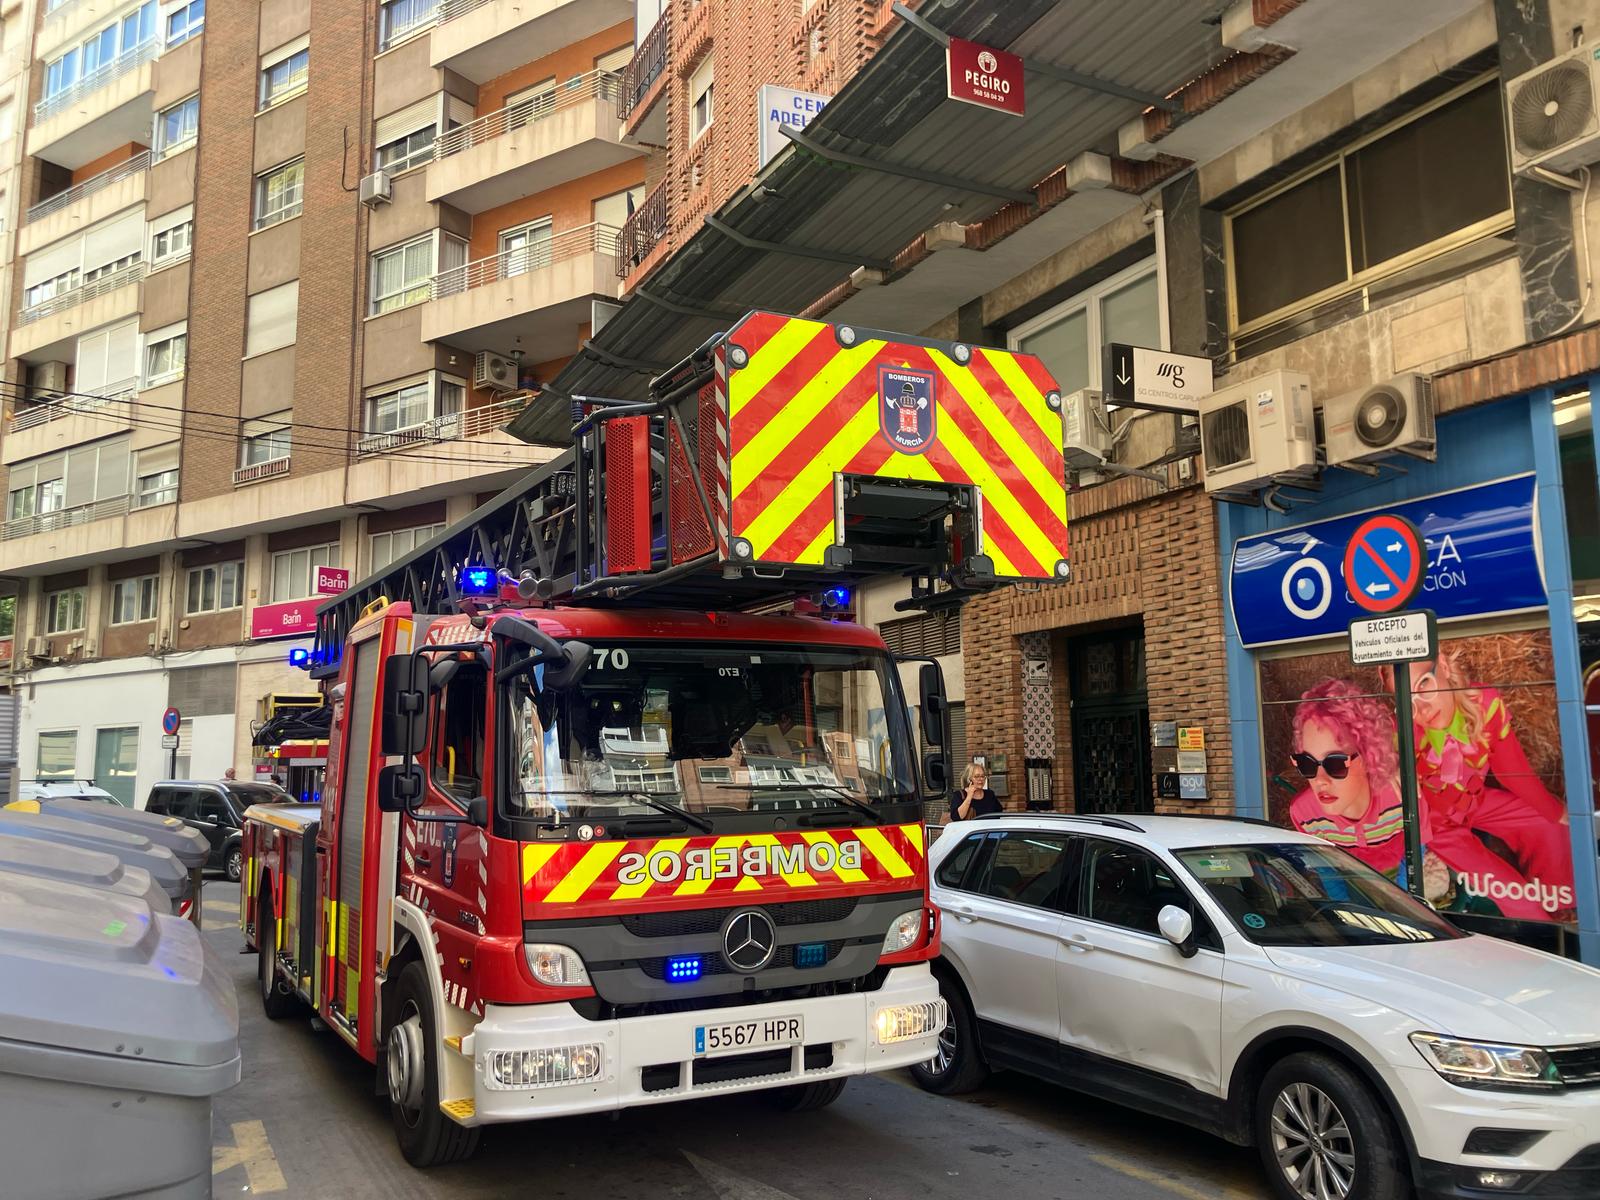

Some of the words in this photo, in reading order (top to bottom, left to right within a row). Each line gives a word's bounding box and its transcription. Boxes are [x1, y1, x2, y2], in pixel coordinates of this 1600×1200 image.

[965, 69, 1010, 94] PEGIRO
[888, 373, 925, 384] BOMBEROS
[895, 434, 923, 446] MURCIA
[320, 574, 346, 589] Barin
[283, 610, 301, 625] Barin
[1367, 618, 1407, 633] EXCEPTO
[1384, 634, 1410, 644] Oficiales
[1413, 632, 1423, 641] del
[588, 648, 629, 670] 70
[1354, 650, 1392, 660] Ayuntamiento
[1406, 646, 1427, 655] Murcia
[1457, 872, 1572, 912] Woodys
[709, 1023, 757, 1048] 5567
[764, 1019, 799, 1041] HPR
